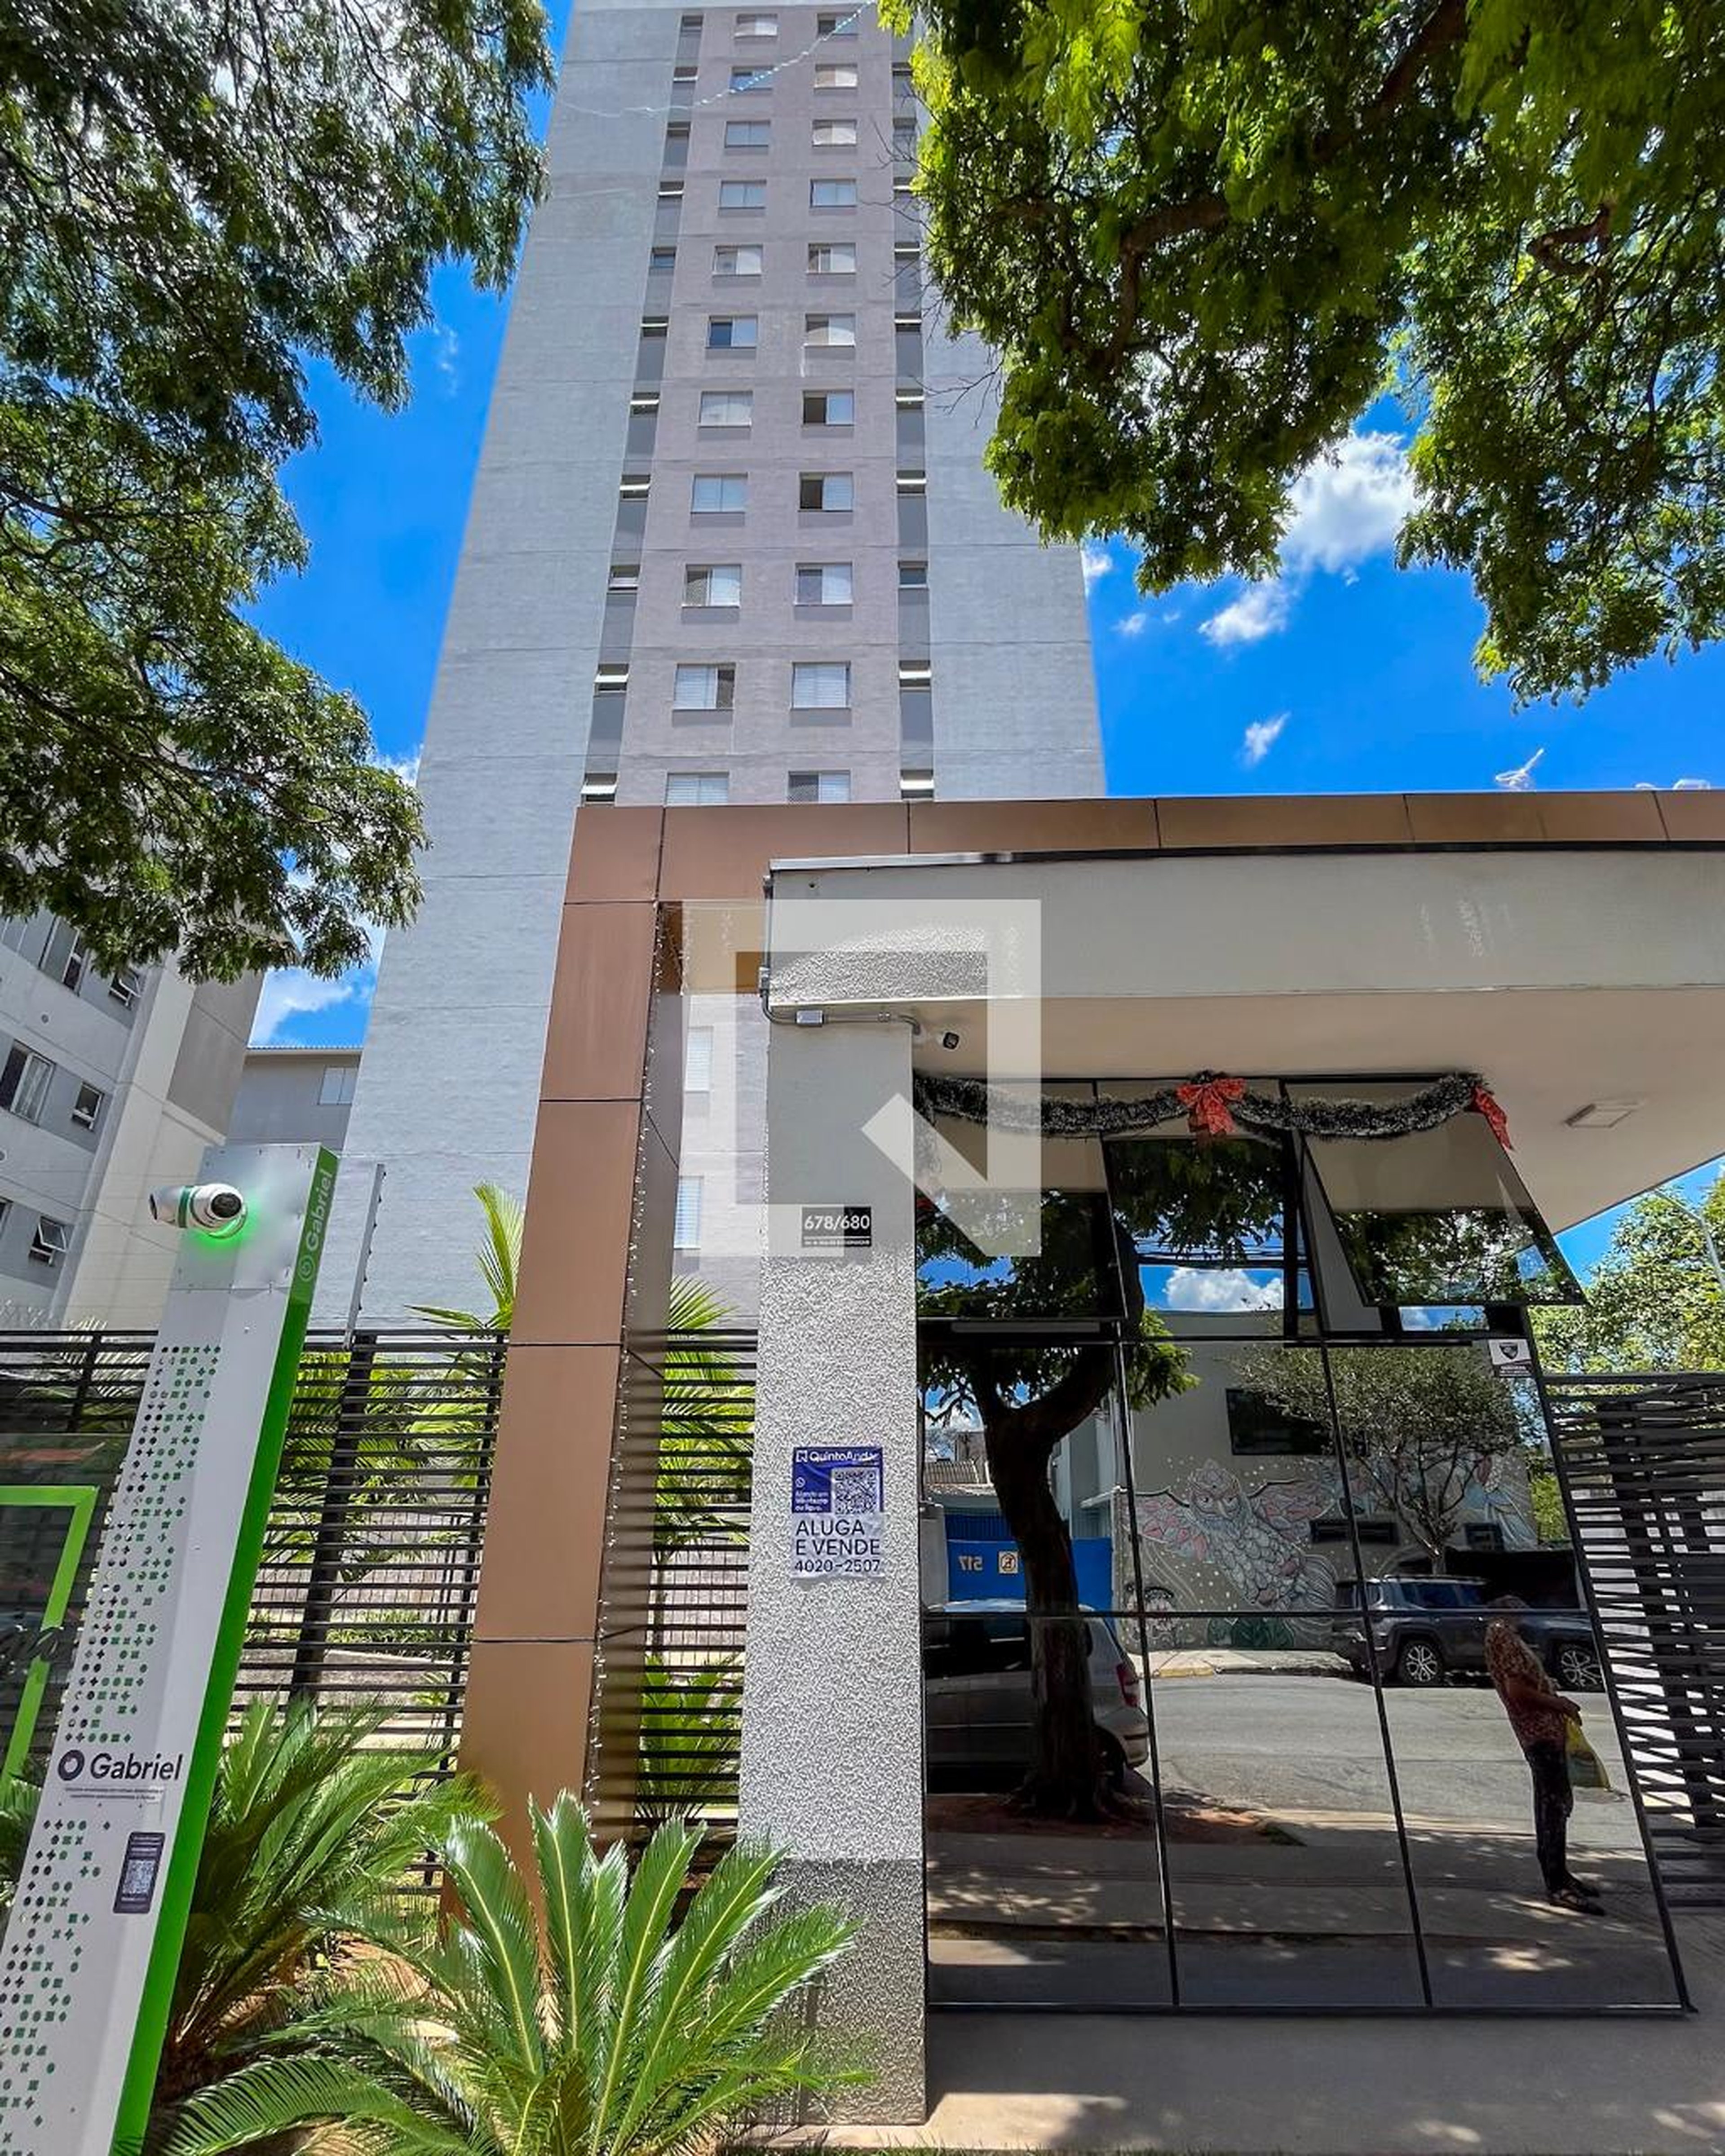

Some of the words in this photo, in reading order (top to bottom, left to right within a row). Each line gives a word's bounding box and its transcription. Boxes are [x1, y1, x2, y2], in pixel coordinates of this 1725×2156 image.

[306, 1169, 332, 1251] Gabriel
[804, 1215, 870, 1230] 678/680
[796, 1519, 865, 1536] ALUGA
[796, 1539, 806, 1555] E
[812, 1539, 880, 1555] VENDE
[795, 1560, 880, 1573] 4020-2507
[90, 1753, 184, 1780] Gabriel
